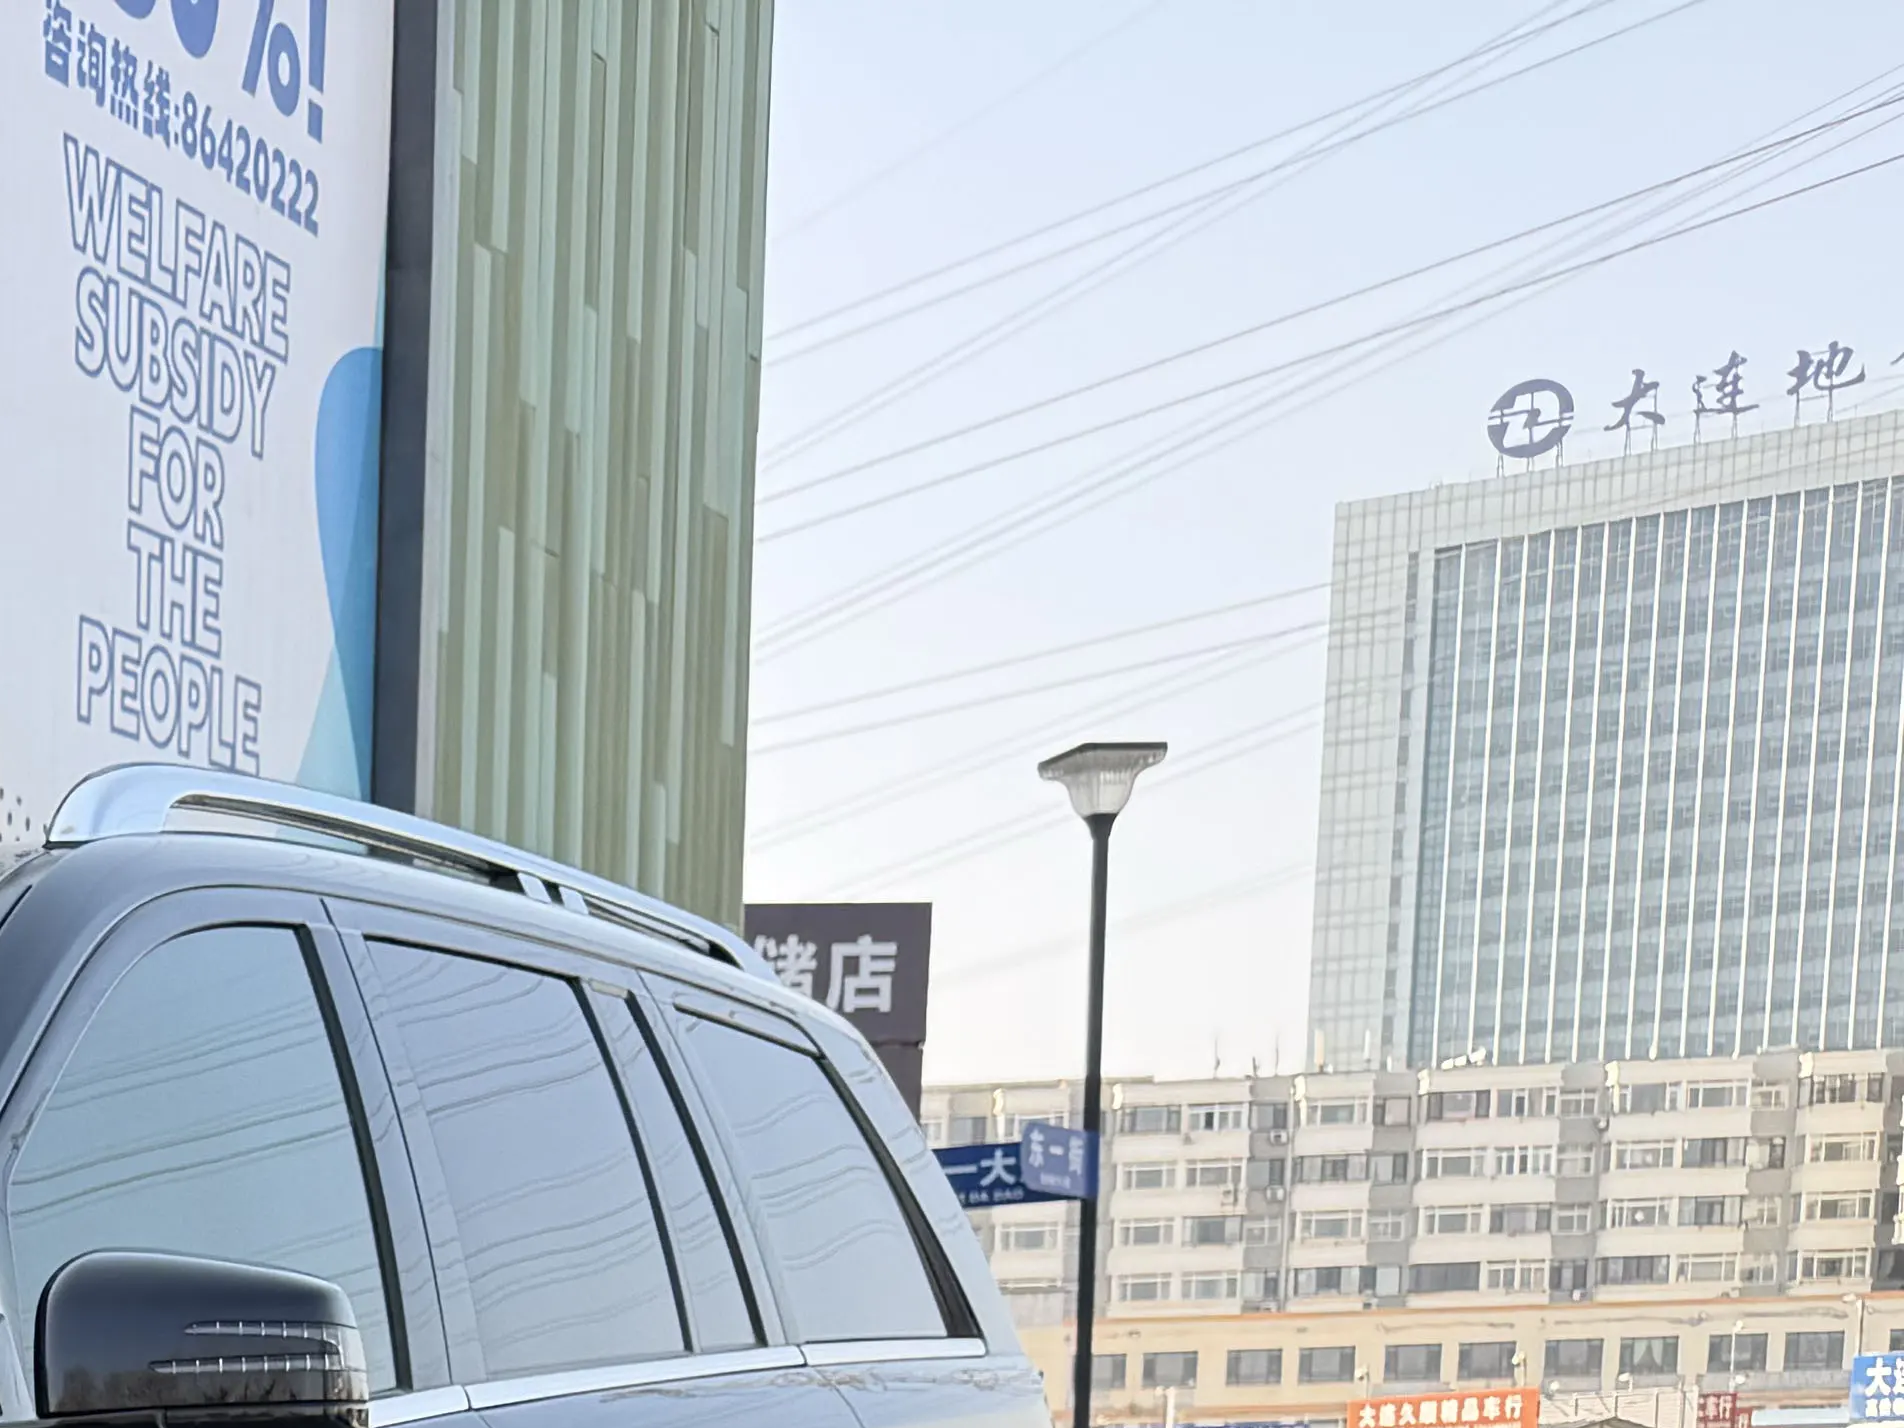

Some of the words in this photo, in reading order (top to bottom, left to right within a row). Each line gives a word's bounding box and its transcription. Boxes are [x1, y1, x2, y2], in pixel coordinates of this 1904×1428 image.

[63, 132, 291, 364] WELFARE
[76, 266, 275, 460] SUBSIDY
[1604, 340, 1904, 431] 大连地
[128, 405, 224, 551] FOR
[126, 520, 223, 656] THE
[77, 614, 261, 776] PEOPLE
